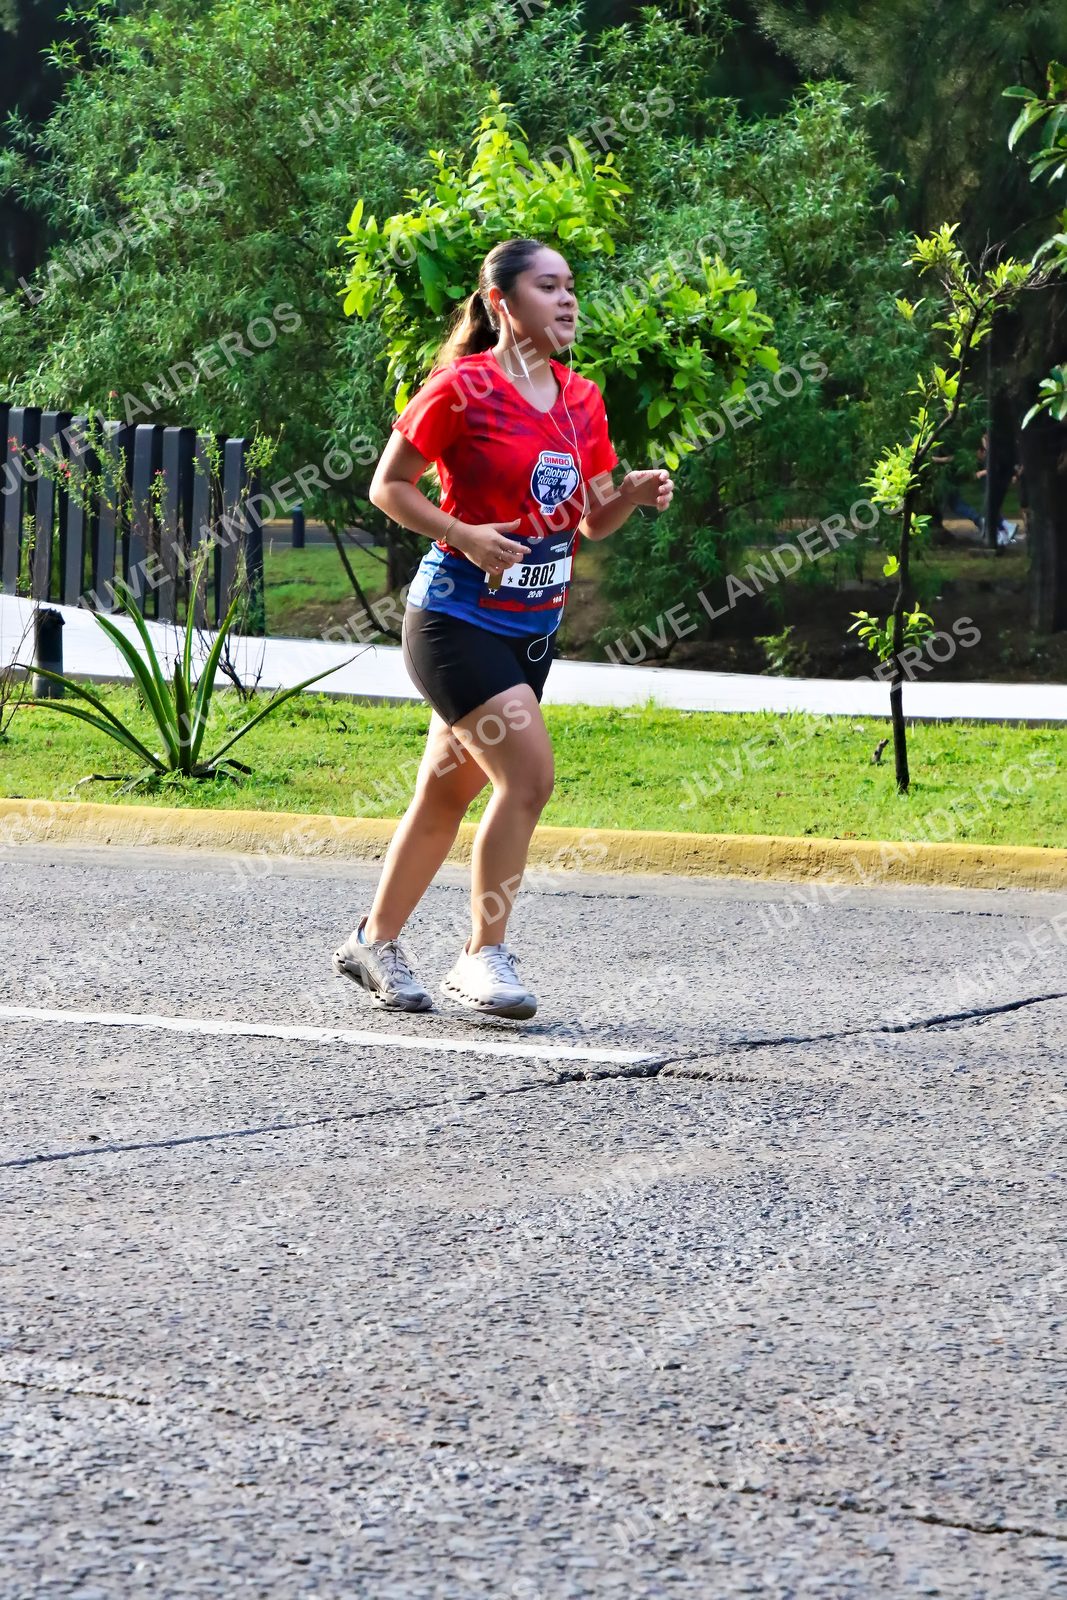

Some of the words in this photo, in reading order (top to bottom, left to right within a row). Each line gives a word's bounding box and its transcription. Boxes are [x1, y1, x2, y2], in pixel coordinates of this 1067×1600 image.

[544, 456, 570, 466] BIMBO
[545, 467, 570, 479] Global
[538, 474, 558, 485] Race
[518, 563, 555, 587] 3802
